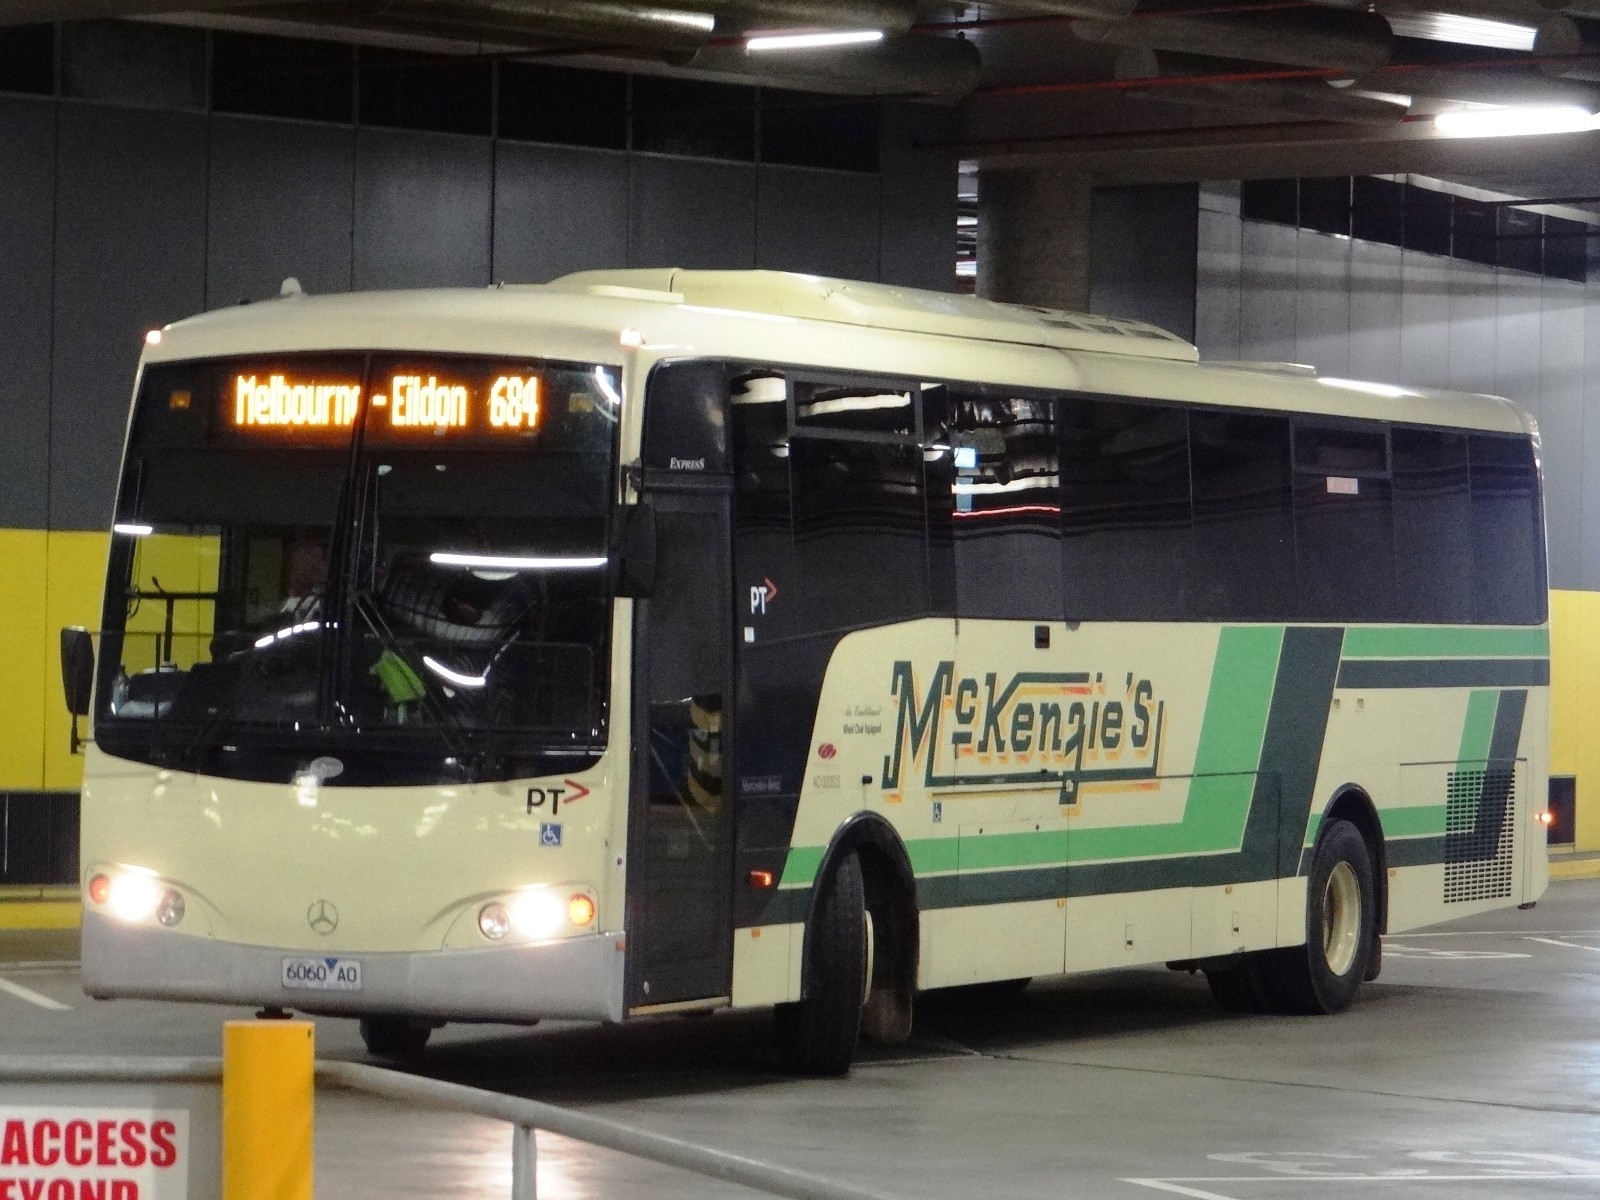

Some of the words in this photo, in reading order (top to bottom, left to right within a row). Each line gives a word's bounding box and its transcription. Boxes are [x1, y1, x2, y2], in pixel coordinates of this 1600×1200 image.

[392, 376, 467, 426] Eildon
[489, 376, 538, 426] 684
[750, 586, 768, 615] PT
[527, 788, 565, 816] PT
[287, 963, 326, 981] 6060
[0, 1119, 177, 1167] ACCESS
